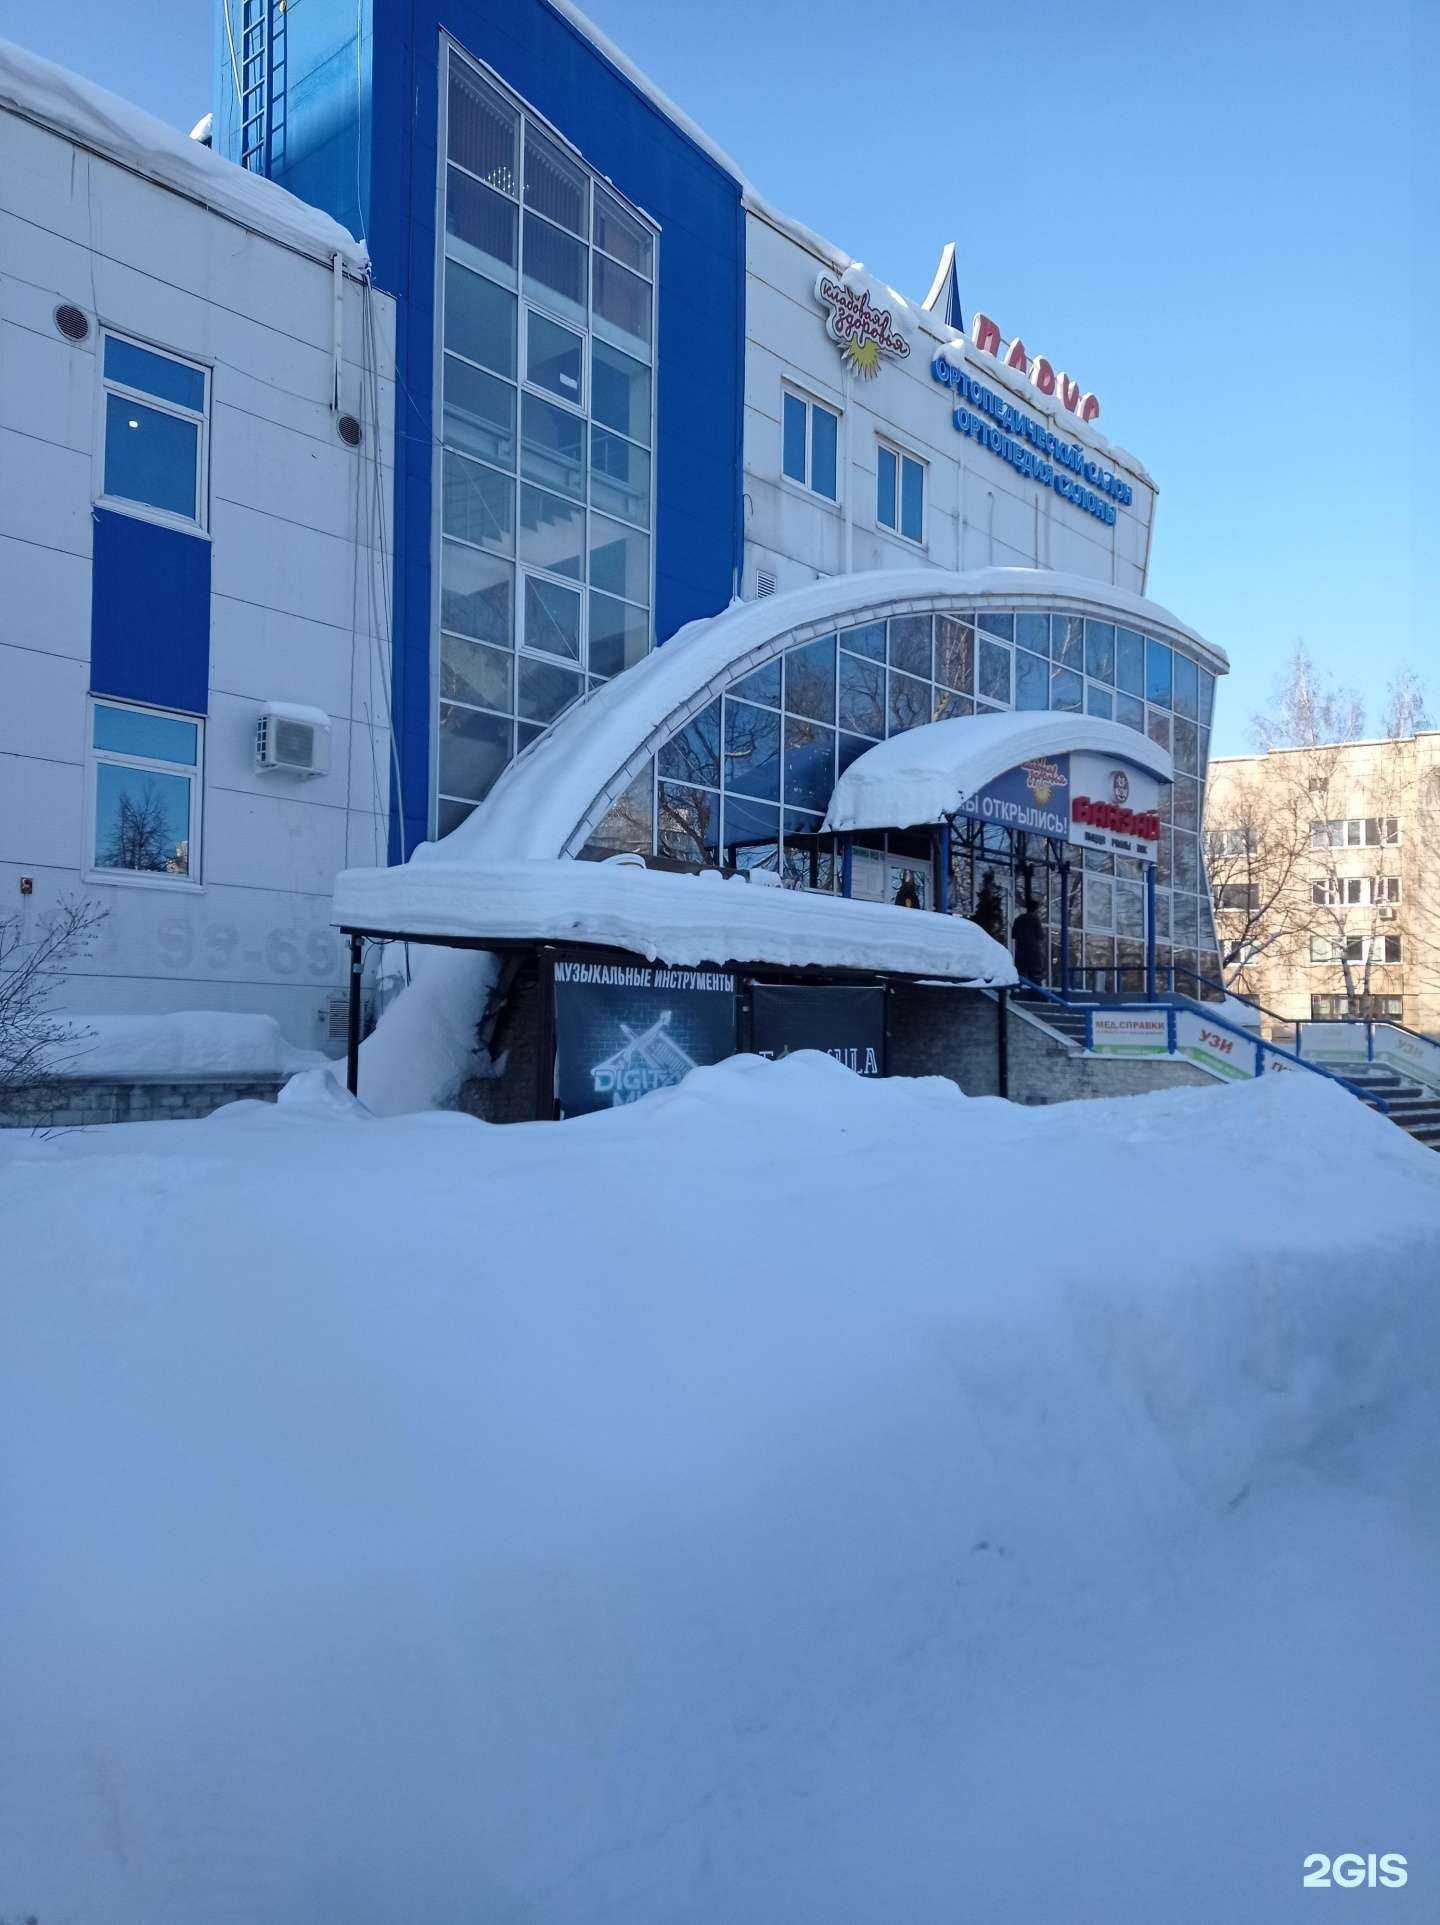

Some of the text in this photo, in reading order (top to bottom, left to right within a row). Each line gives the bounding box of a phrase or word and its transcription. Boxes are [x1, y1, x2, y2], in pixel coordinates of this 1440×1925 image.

[931, 355, 1085, 477] ОРТОПЕДИЧЕСКИЙ
[953, 406, 1117, 526] ОРТОПЕДИЯ САЛОНЫ
[961, 795, 1068, 835] Ы ОТКРЫЛИСЬ!
[554, 962, 735, 992] МУЗЫКАЛЬНЫЕ ИНСТРУМЕНТЫ
[1200, 1029, 1235, 1054] УЗИ
